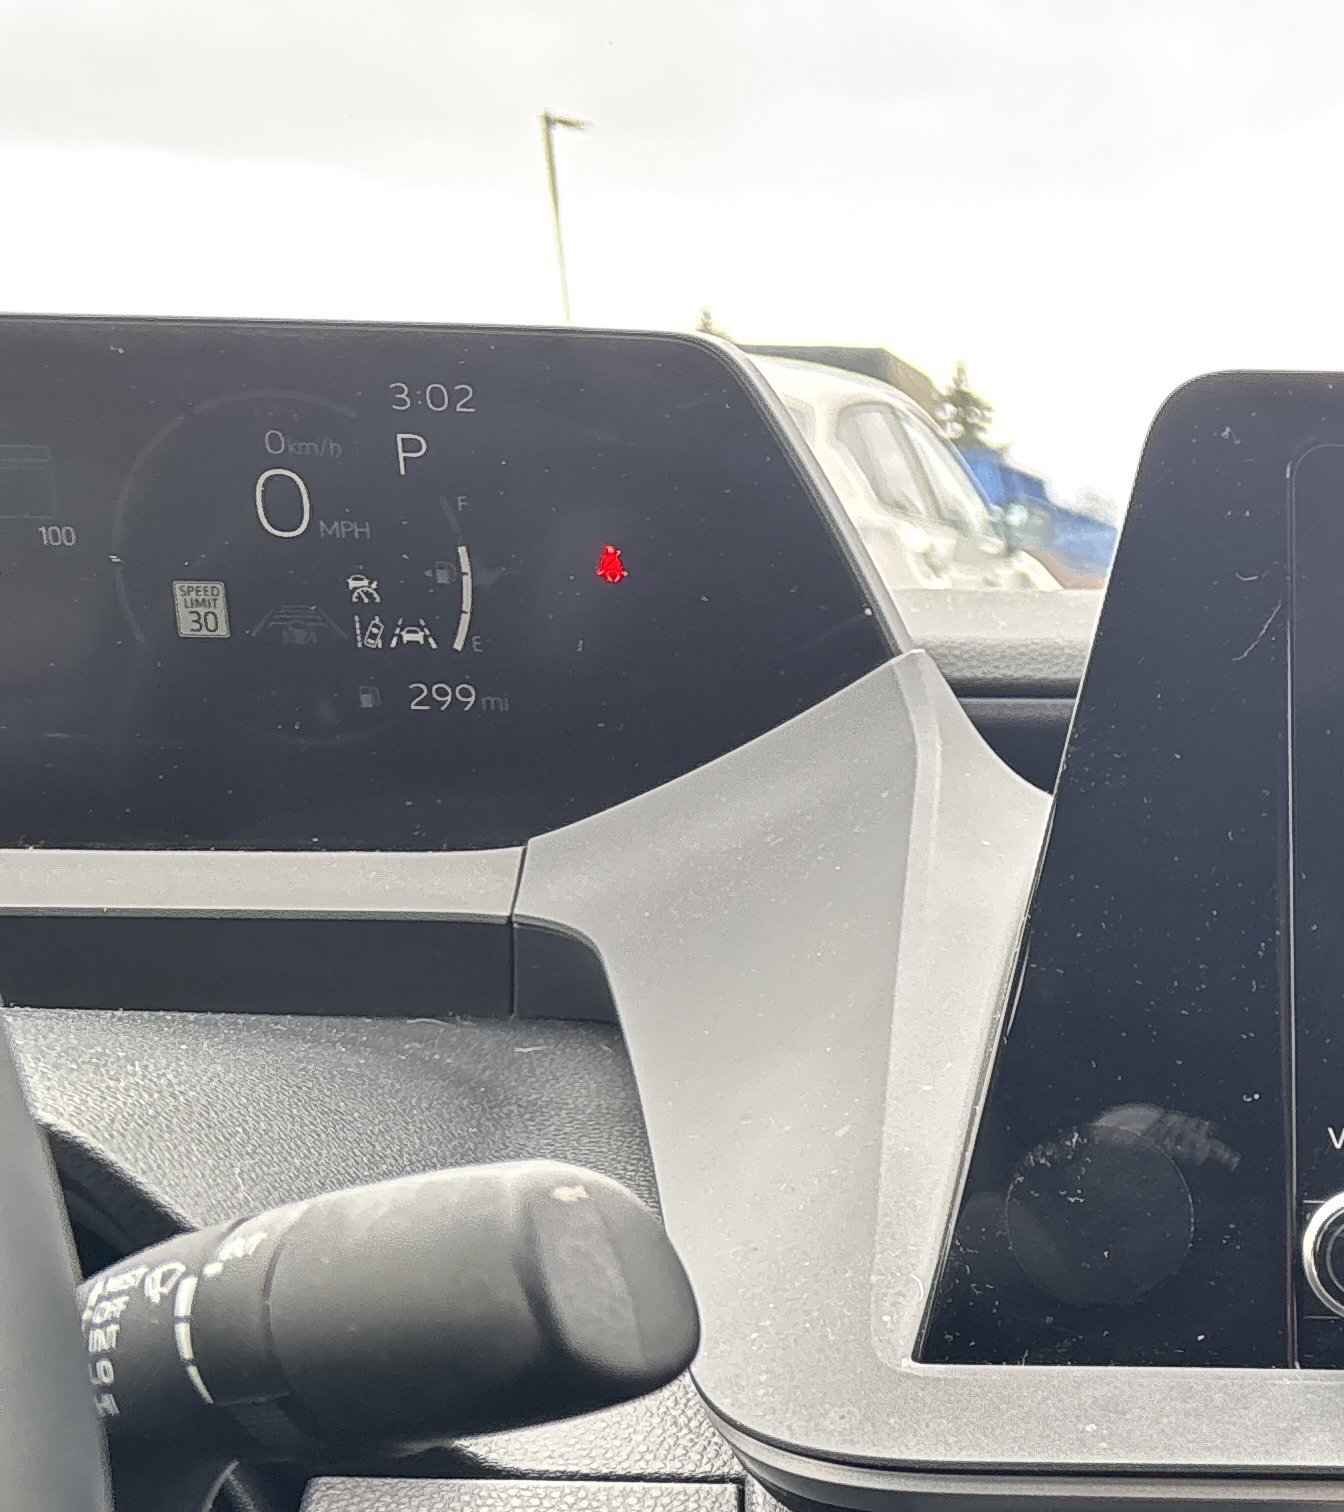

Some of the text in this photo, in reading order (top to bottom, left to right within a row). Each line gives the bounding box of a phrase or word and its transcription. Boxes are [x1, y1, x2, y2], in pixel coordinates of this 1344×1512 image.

[389, 382, 476, 412] 3:02
[396, 433, 427, 475] P
[255, 468, 371, 539] 0 MPH
[457, 496, 469, 511] F
[38, 526, 76, 546] 100
[179, 585, 221, 597] SPEED
[183, 599, 219, 609] LIMIT
[188, 610, 220, 633] 30
[472, 635, 483, 652] E
[408, 683, 509, 711] 299 mi
